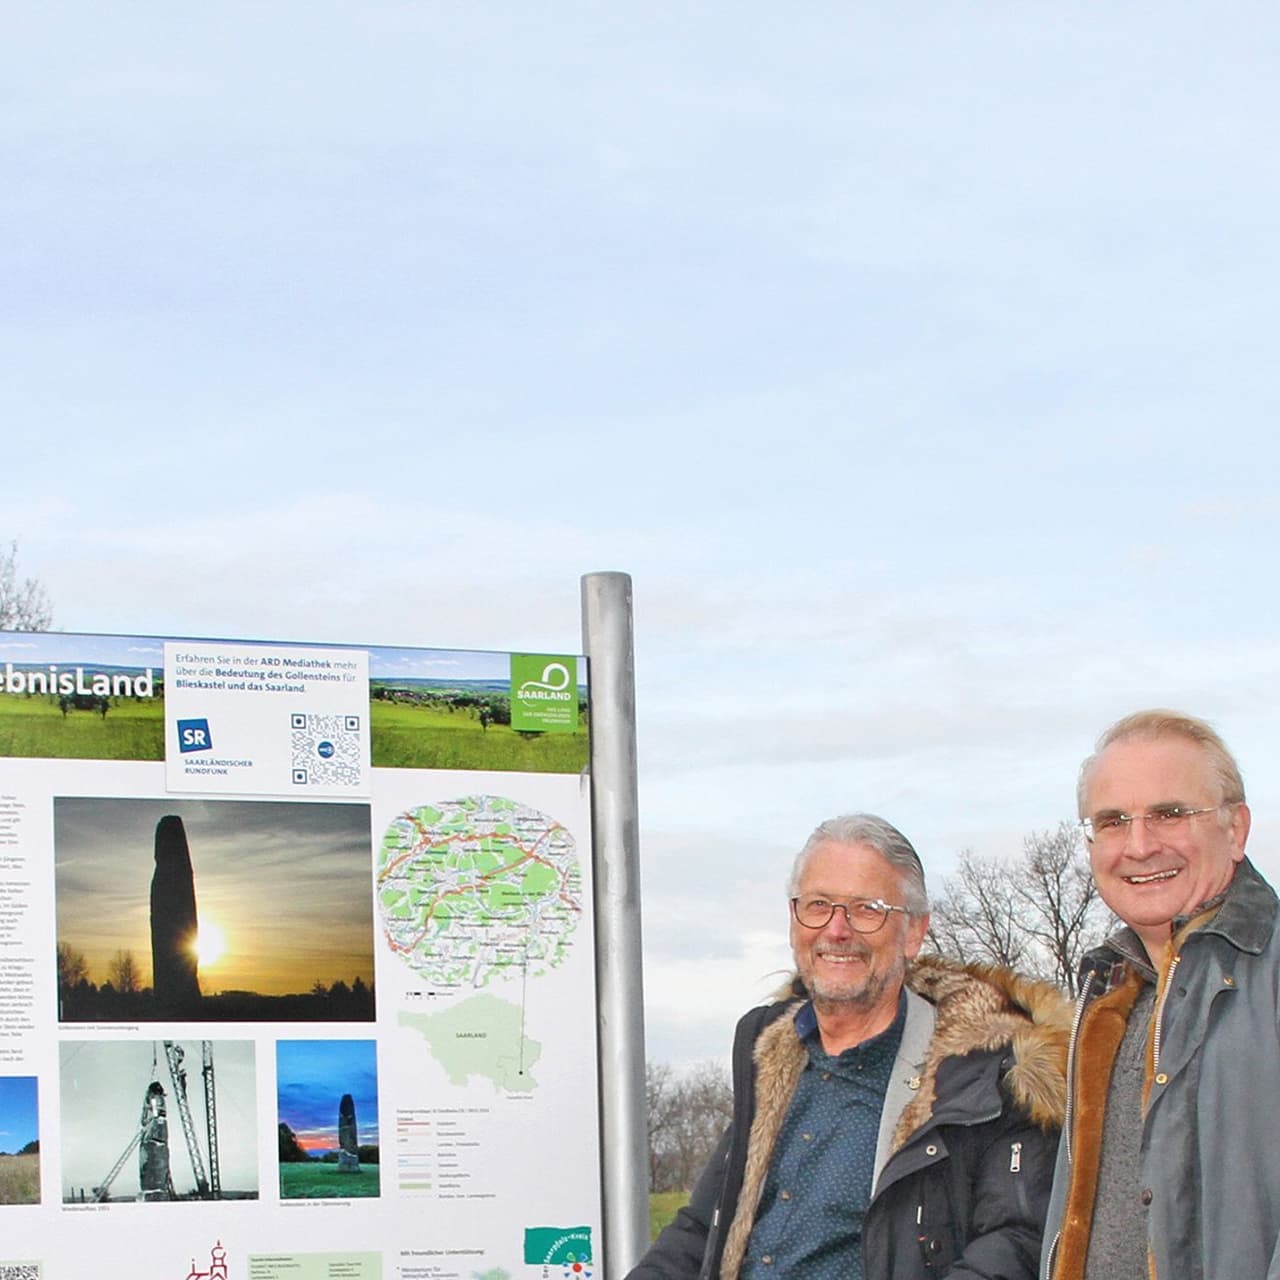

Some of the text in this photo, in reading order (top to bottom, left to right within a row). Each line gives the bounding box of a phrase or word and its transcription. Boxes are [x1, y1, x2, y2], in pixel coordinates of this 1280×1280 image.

[175, 654, 357, 670] Erfahren Sie in der ARD Mediathek mehr
[175, 667, 357, 683] über die Bedeutung des Gollensteins für
[176, 680, 226, 690] Blieskastel
[227, 681, 246, 691] und
[247, 682, 263, 692] das
[517, 690, 571, 700] SAARLAND
[183, 729, 207, 746] SR
[184, 757, 254, 767] SAARLÄNDISCHER
[184, 767, 229, 776] RUNDFUNK
